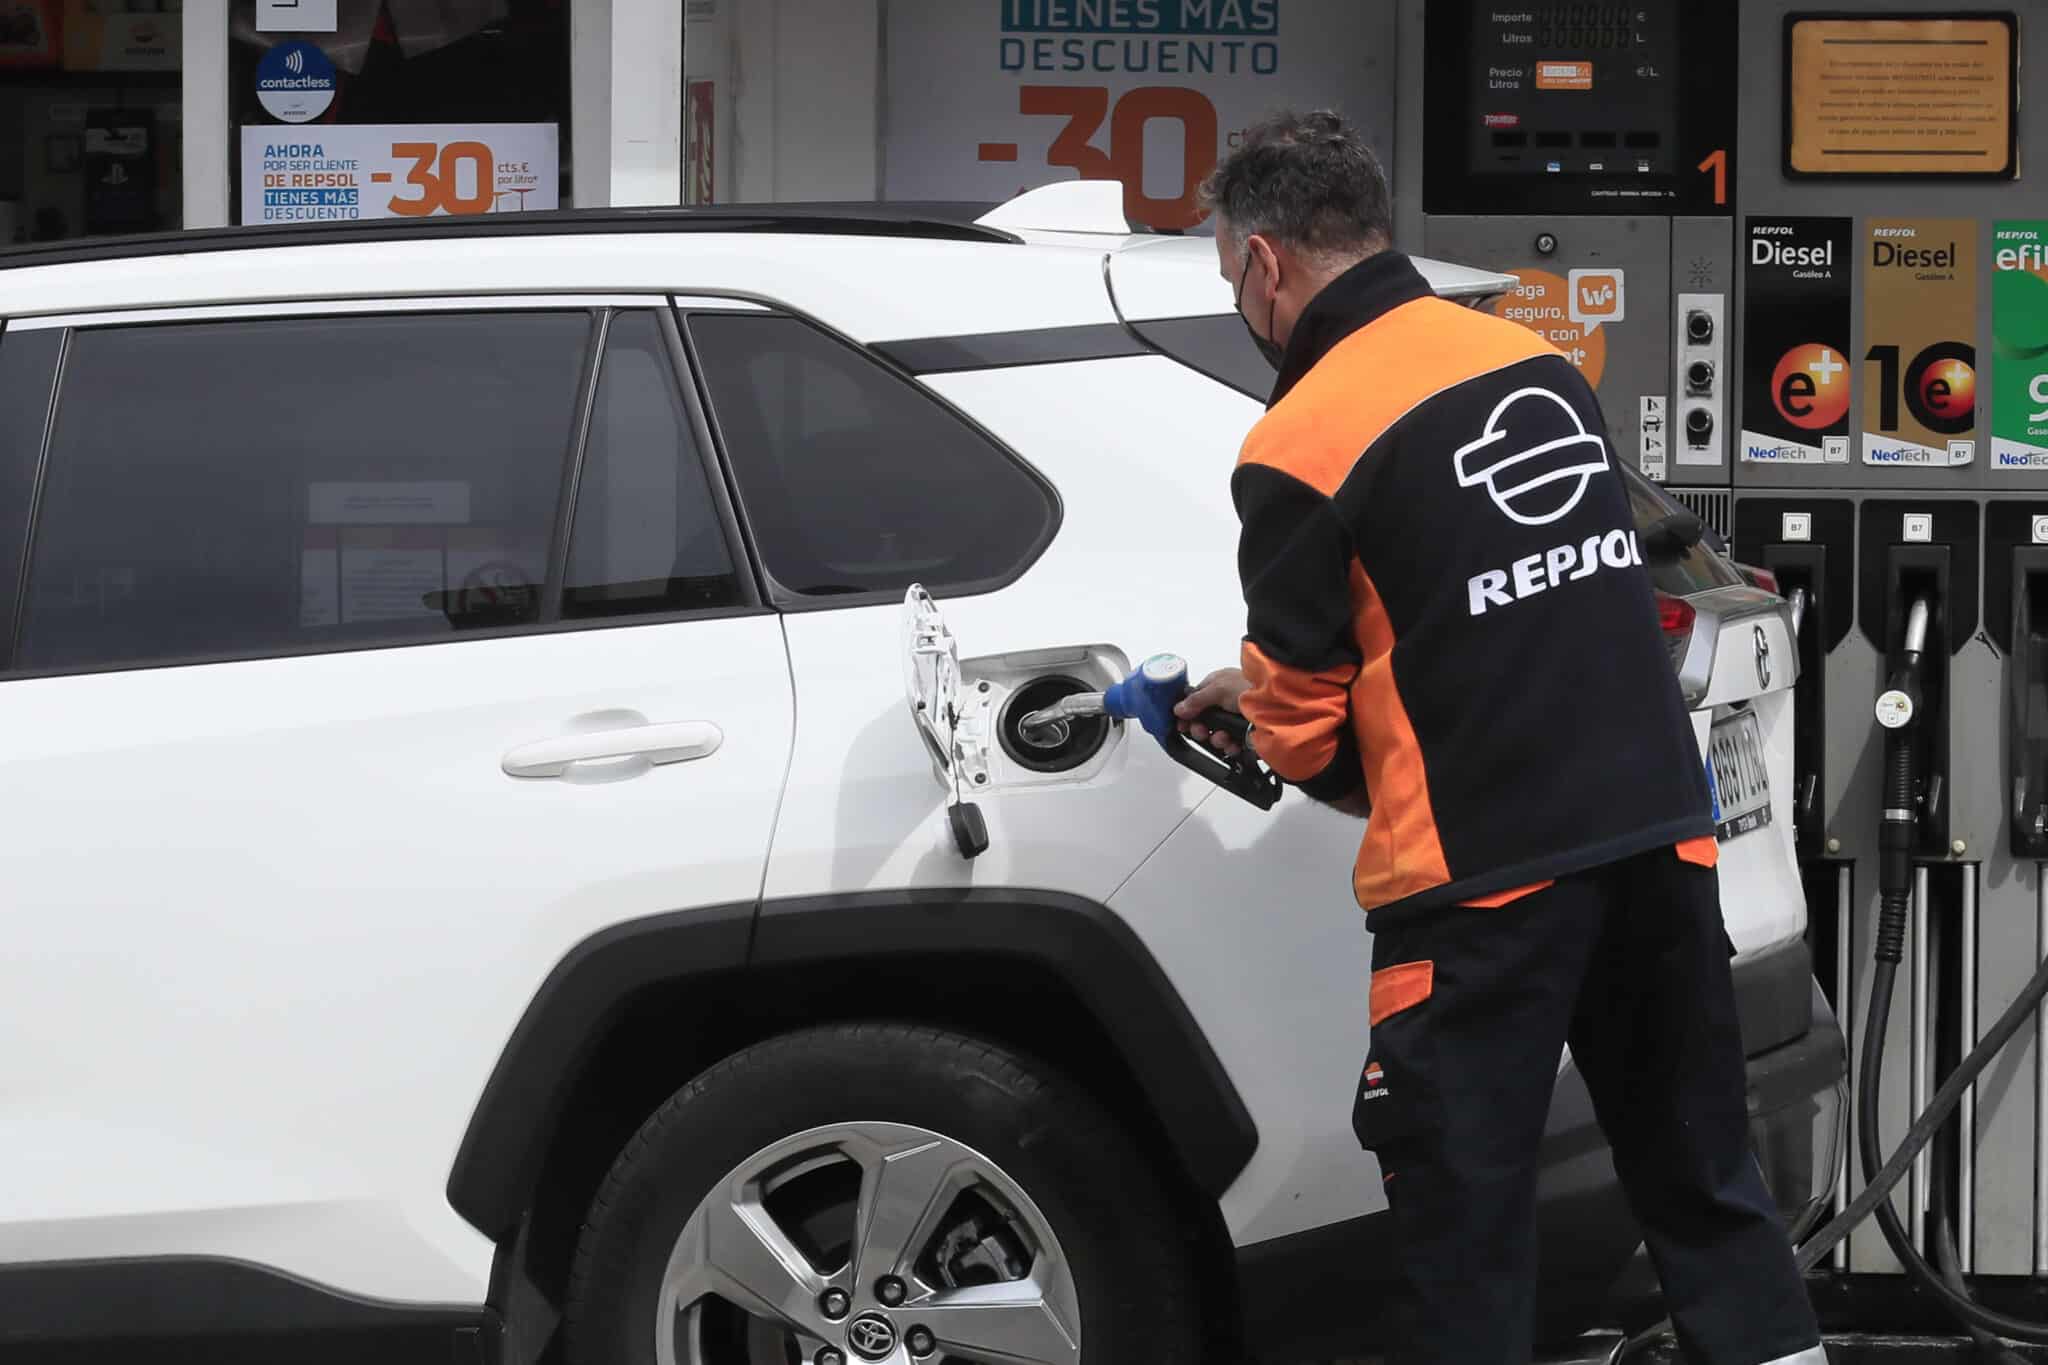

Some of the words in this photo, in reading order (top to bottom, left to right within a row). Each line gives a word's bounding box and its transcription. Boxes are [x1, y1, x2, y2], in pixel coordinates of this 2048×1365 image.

[1008, 0, 1160, 28] TIENES
[1492, 11, 1533, 23] Importe
[1502, 33, 1532, 43] Litros
[1001, 38, 1278, 74] DESCUENTO
[1489, 67, 1522, 78] Precio
[260, 75, 331, 89] contactless
[1489, 79, 1520, 89] Litros
[264, 144, 324, 158] AHORA
[978, 84, 1218, 231] -30
[264, 160, 287, 171] POR
[290, 160, 311, 171] SER
[313, 160, 359, 171] CLIENTE
[264, 174, 286, 187] DE
[292, 173, 358, 187] REPSOL
[370, 141, 494, 217] -30
[1698, 150, 1726, 204] 1
[266, 191, 319, 205] TIENES
[324, 188, 357, 204] MÁS
[264, 207, 359, 220] DESCUENTO
[1752, 226, 1794, 235] REPSOL
[1873, 228, 1917, 237] REPSOL
[1997, 231, 2038, 240] REPSOL
[1752, 239, 1833, 266] Diesel
[1873, 241, 1956, 268] Diesel
[1504, 306, 1565, 322] seguro,
[1550, 329, 1579, 341] con
[1748, 446, 1807, 460] NeoTech
[1871, 448, 1931, 461] NeoTech
[1791, 523, 1802, 531] B7
